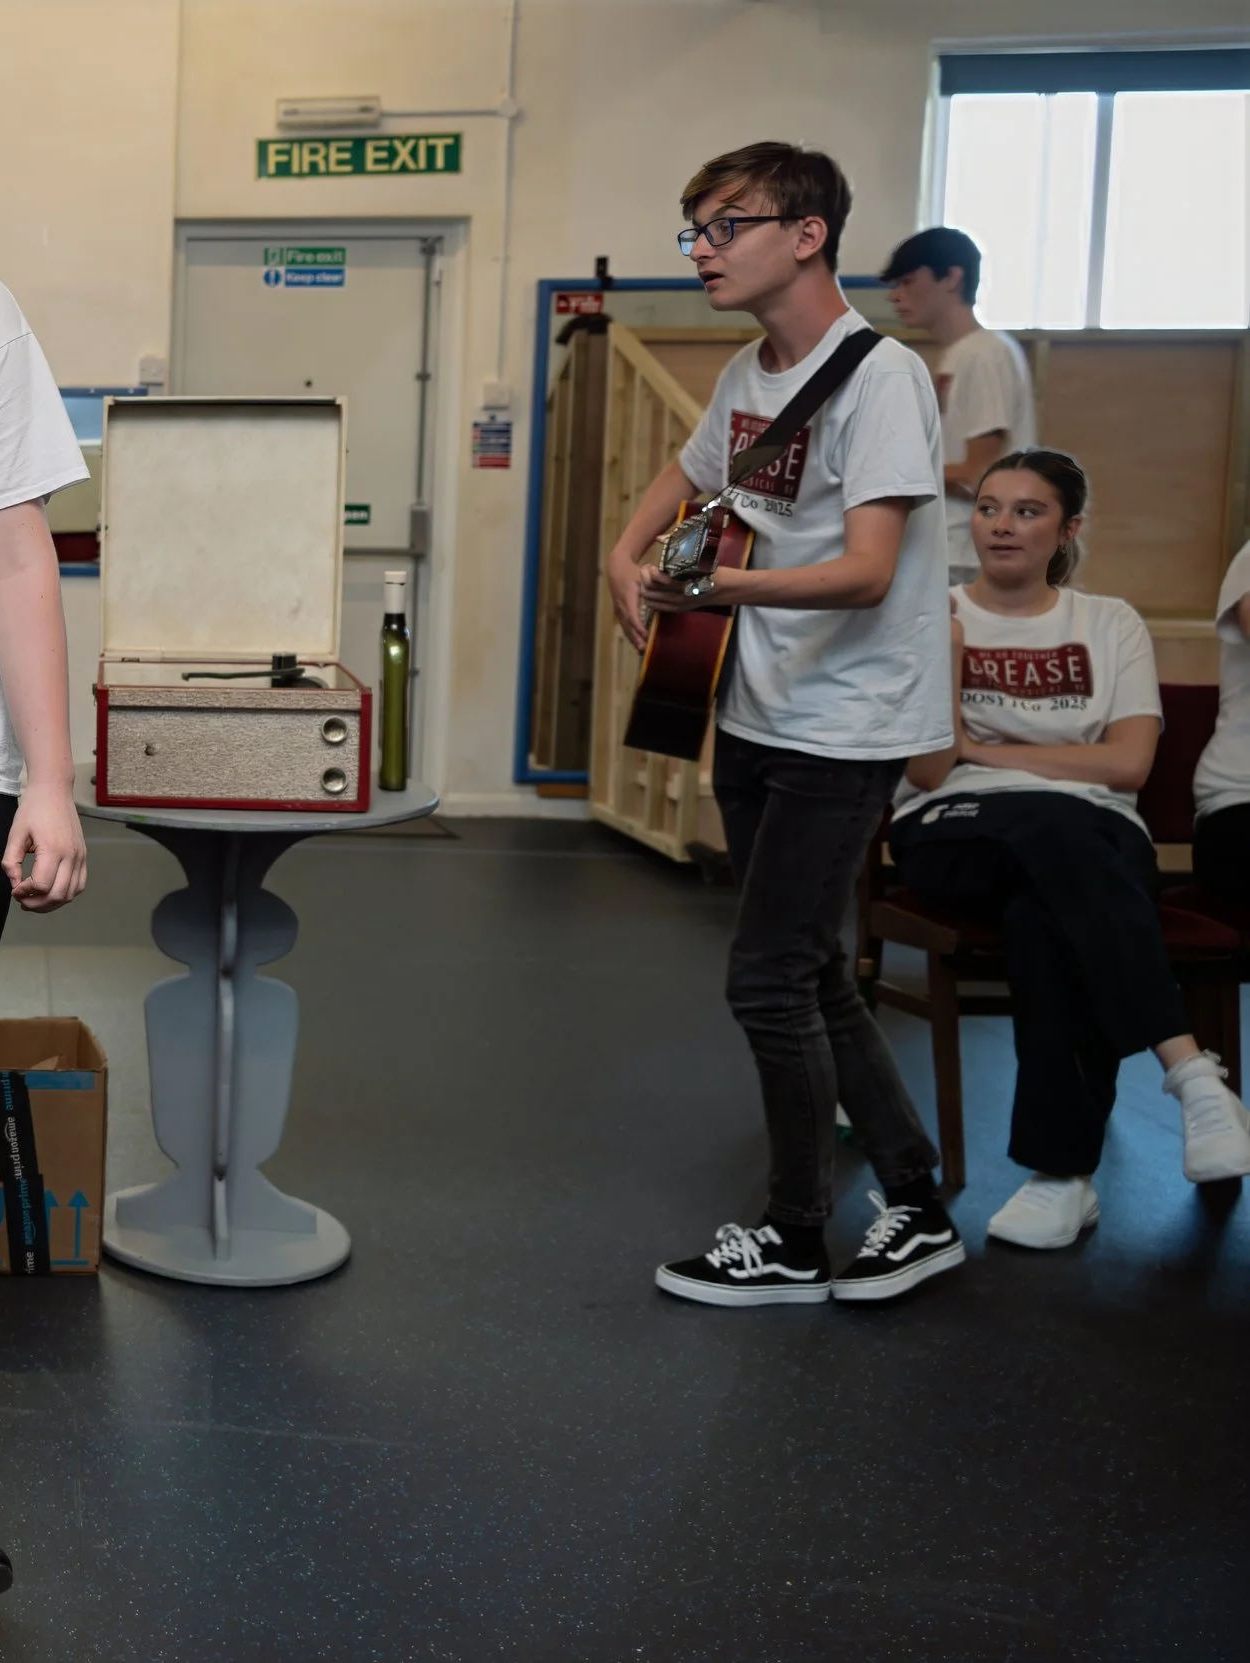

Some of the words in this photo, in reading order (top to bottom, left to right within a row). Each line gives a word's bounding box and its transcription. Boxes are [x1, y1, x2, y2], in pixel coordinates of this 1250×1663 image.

[266, 141, 354, 175] FIRE
[364, 137, 455, 172] EXIT
[287, 250, 315, 264] Fire
[316, 250, 343, 263] exit
[286, 271, 315, 285] Keep
[315, 271, 343, 284] clear
[1049, 696, 1088, 711] 2025
[4, 1117, 19, 1153] amazon
[11, 1153, 24, 1180] prim
[23, 1251, 36, 1274] rime
